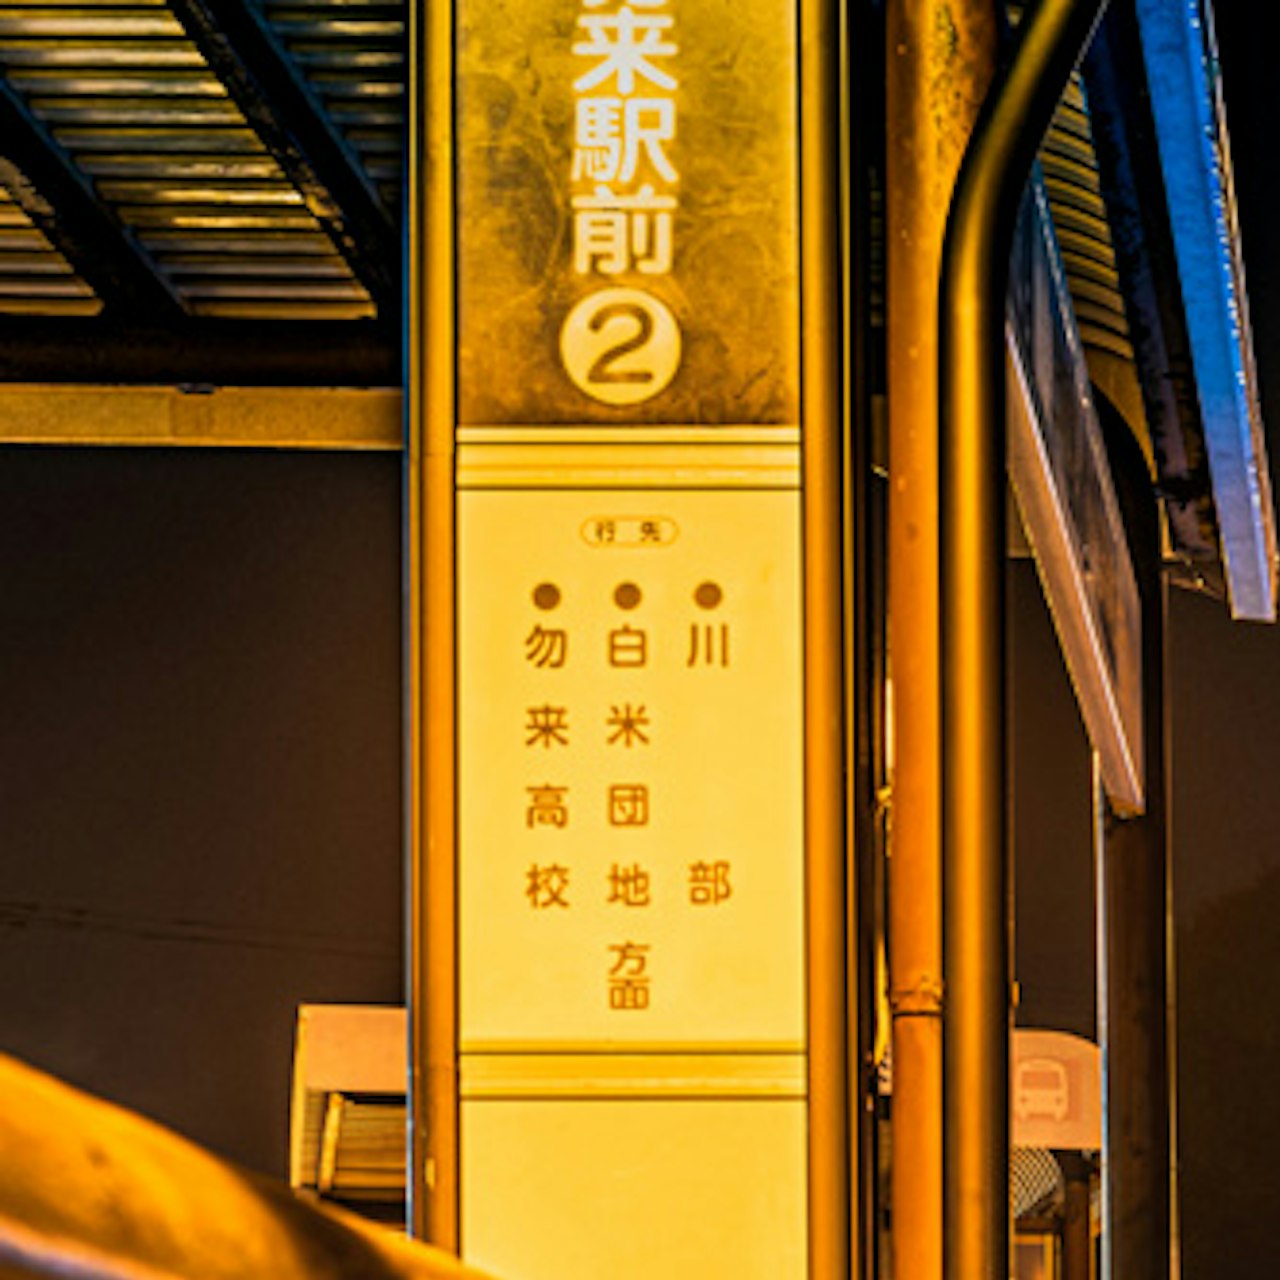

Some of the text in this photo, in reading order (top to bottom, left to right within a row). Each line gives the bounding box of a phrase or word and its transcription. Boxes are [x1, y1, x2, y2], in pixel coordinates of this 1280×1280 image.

[570, 0, 680, 276] 来駅前
[523, 622, 570, 910] 勿来高校
